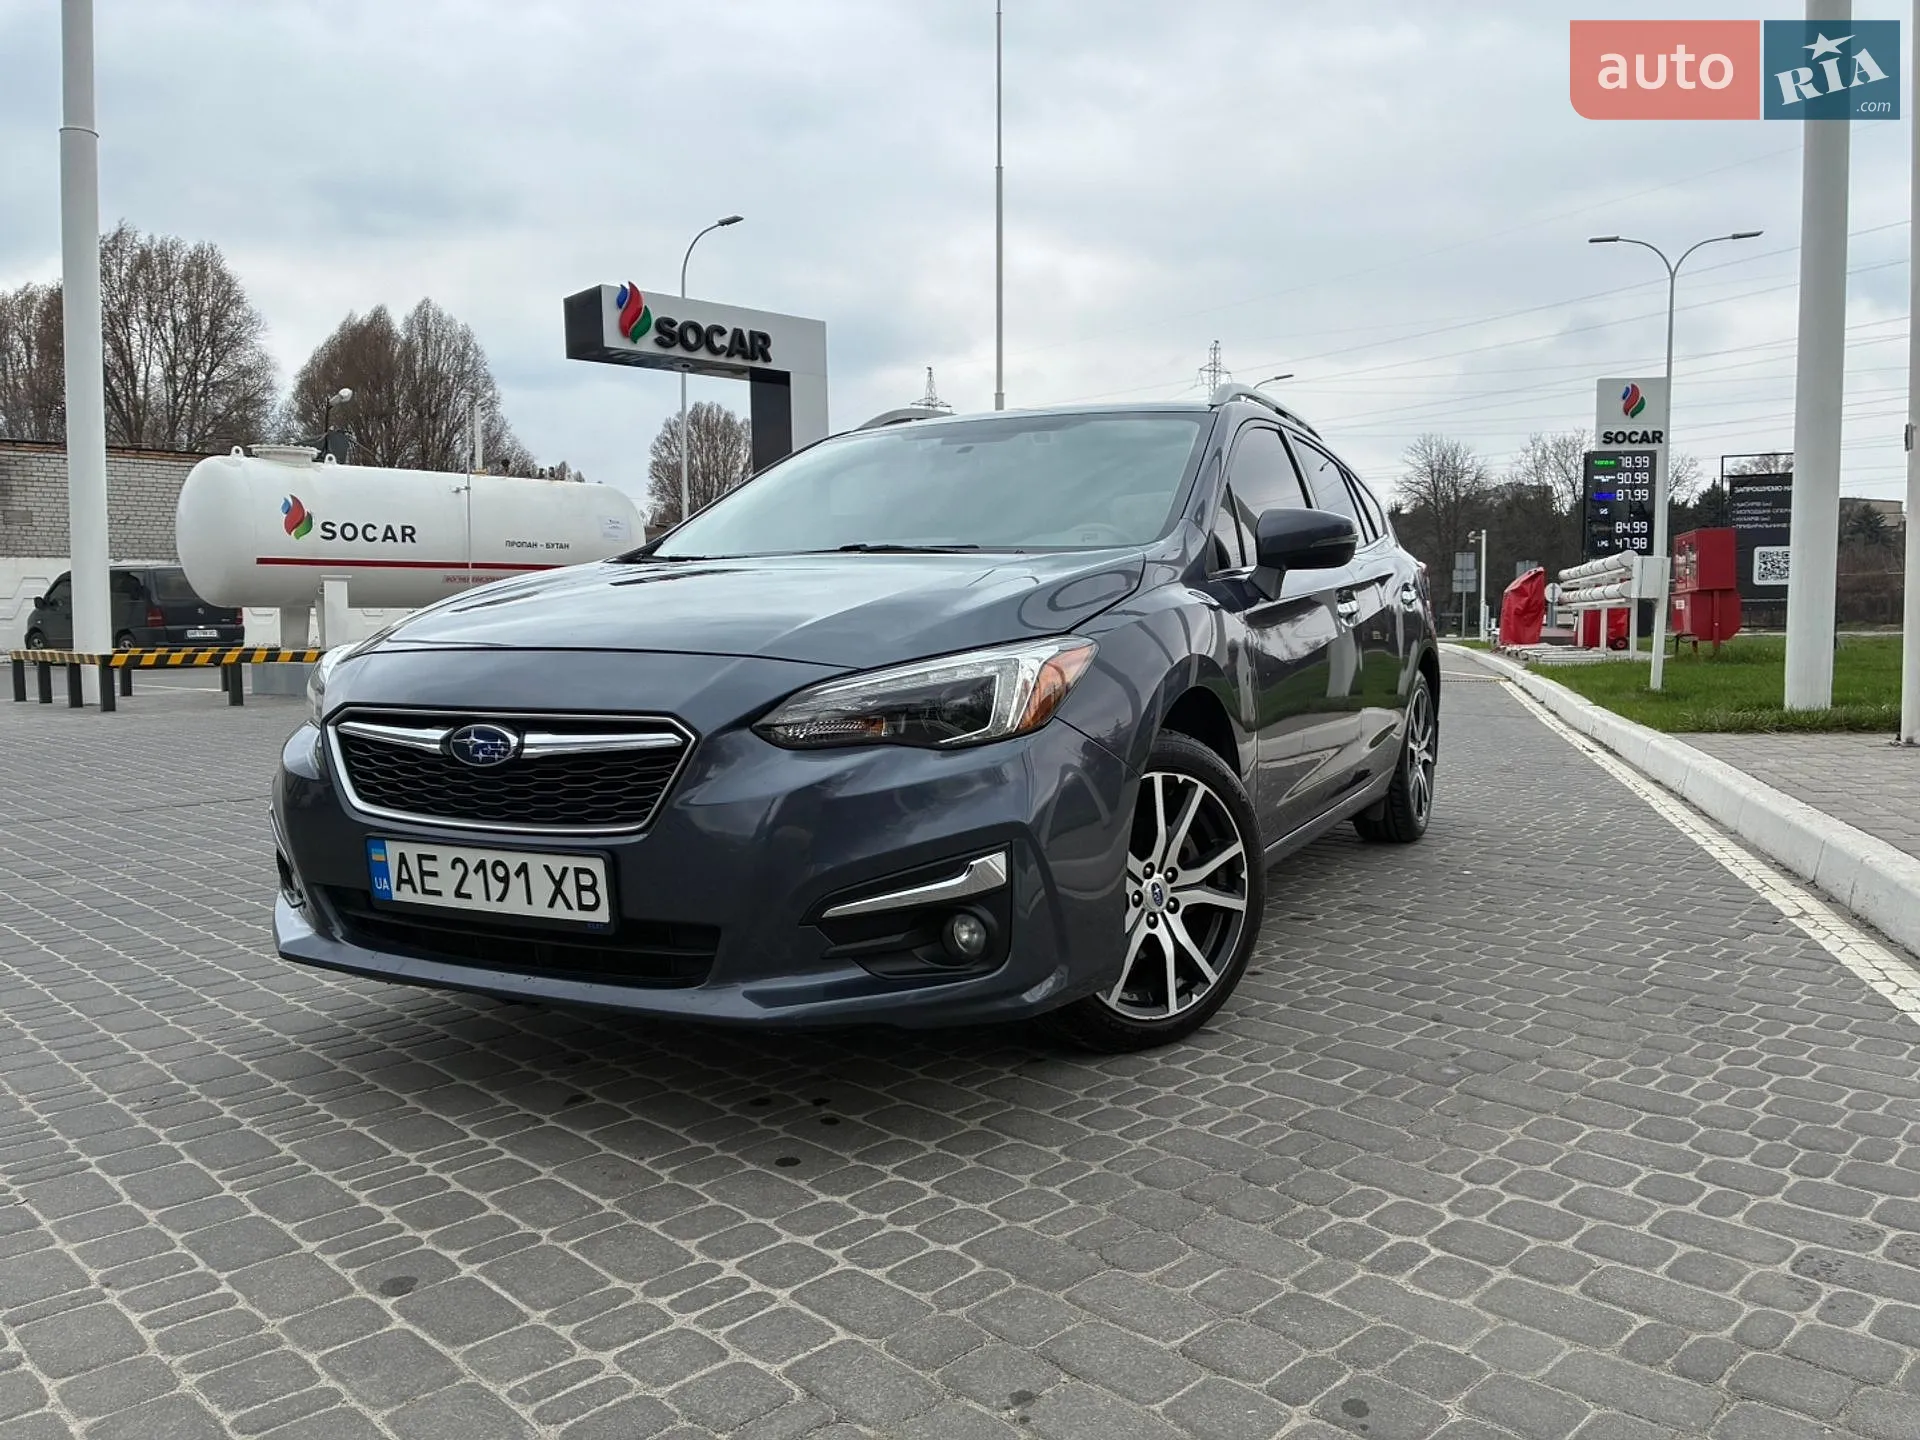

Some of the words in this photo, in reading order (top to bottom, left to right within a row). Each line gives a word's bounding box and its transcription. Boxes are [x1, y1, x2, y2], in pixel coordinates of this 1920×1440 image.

[653, 316, 772, 363] SOCAR
[1602, 430, 1664, 444] SOCAR
[1618, 456, 1650, 468] 78.99
[1617, 472, 1649, 484] 90.99
[1616, 489, 1649, 501] 87.99
[319, 521, 417, 545] SOCAR
[1615, 522, 1648, 534] 84.99
[505, 540, 538, 549] ПРОПАН
[545, 542, 570, 550] БУТАН
[1615, 538, 1647, 550] 47.98
[374, 876, 390, 891] UA
[395, 852, 442, 897] AE
[450, 857, 533, 906] 2191
[543, 864, 601, 912] XB
